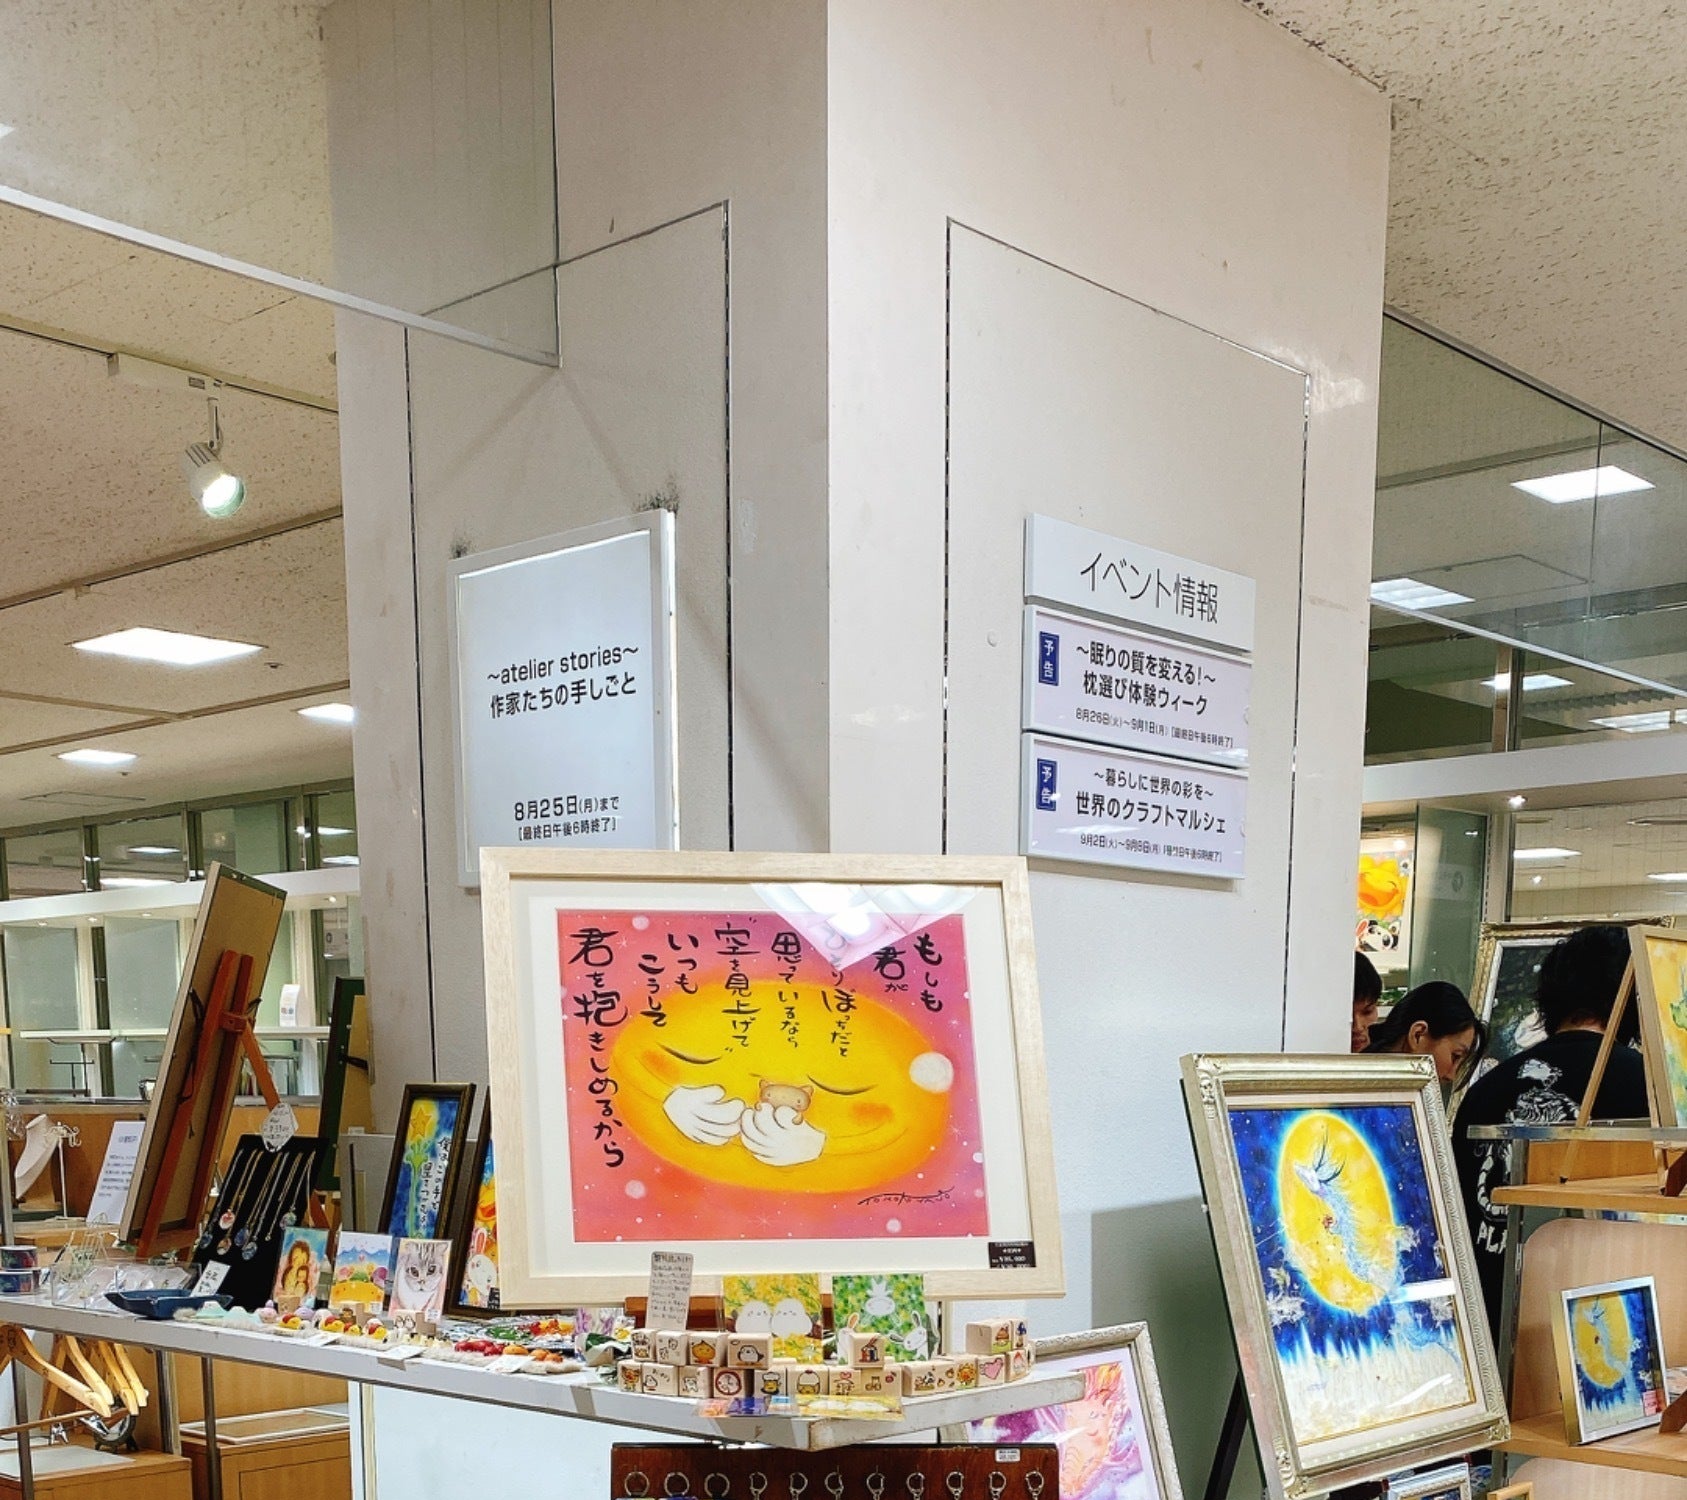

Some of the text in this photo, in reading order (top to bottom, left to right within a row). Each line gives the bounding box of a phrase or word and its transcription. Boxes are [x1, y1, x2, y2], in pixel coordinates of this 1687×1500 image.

[1079, 552, 1218, 624] イベント情報
[1043, 639, 1054, 678] 予告
[490, 672, 636, 719] 作家たちの手しごと
[1083, 670, 1207, 715] 枕選び体験ウィーク
[1076, 791, 1226, 834] 世界のクラフトマルシェ
[638, 954, 667, 1027] こうして
[667, 933, 699, 995] いつも
[771, 932, 802, 1048] 思っているなら
[873, 946, 908, 993] 君が
[913, 933, 943, 1012] もしも
[568, 928, 629, 1168] 君を抱きしめるから
